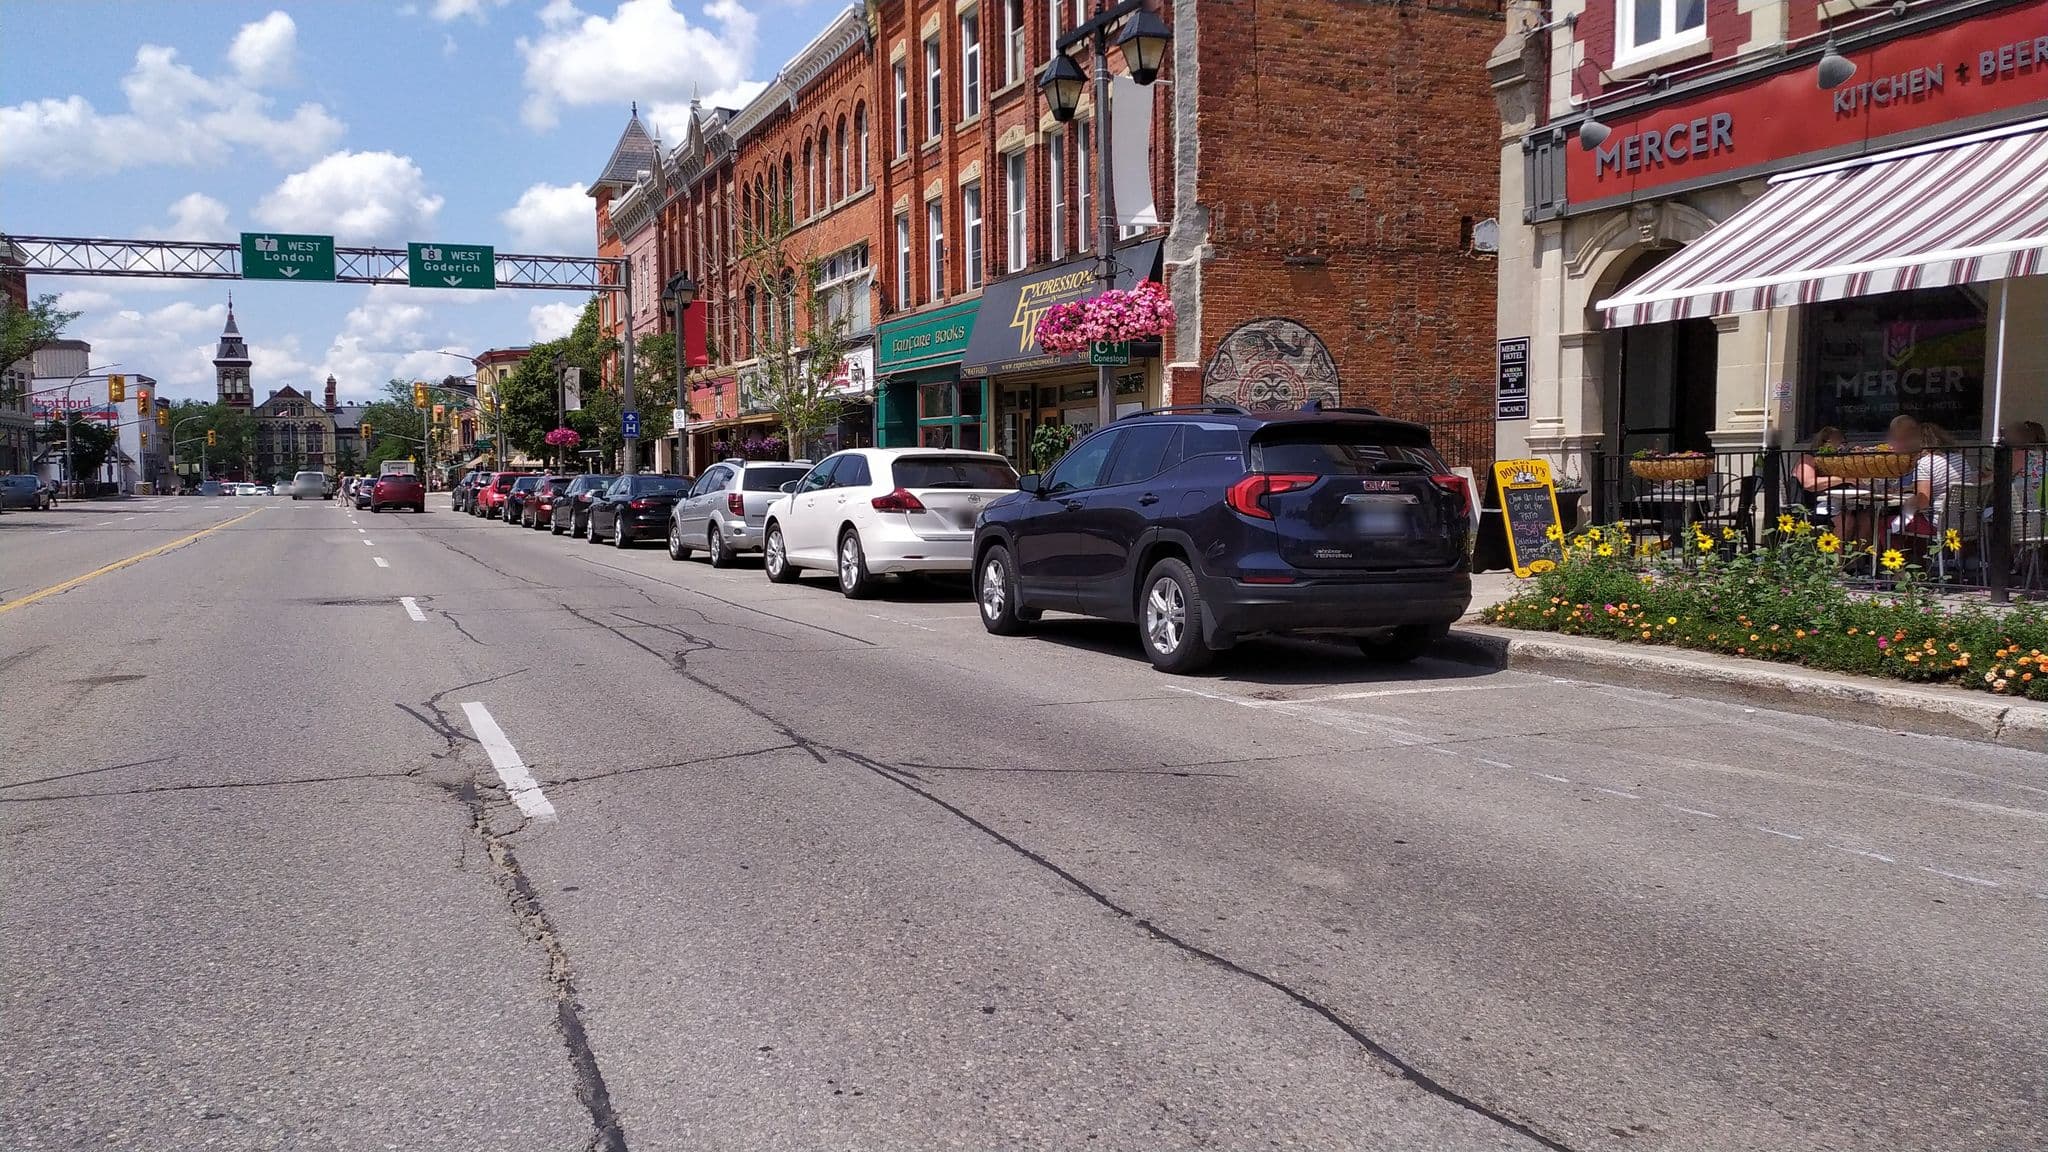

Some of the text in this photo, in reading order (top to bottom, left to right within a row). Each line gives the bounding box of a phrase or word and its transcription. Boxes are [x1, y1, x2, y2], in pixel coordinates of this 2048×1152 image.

[1833, 62, 1945, 113] KITCHEN
[1978, 35, 2048, 77] BEER
[1595, 112, 1735, 178] MERCER
[262, 240, 321, 251] 7 WEST
[264, 252, 314, 262] London
[427, 250, 482, 261] 8 WEST
[423, 262, 480, 273] Goderich
[1501, 343, 1526, 353] MERCER
[1094, 354, 1127, 364] Conestoga
[1503, 351, 1524, 361] HOTEL
[1836, 365, 1964, 398] MERCER
[32, 396, 91, 409] tratford
[1500, 405, 1525, 413] VACANCY
[626, 424, 636, 433] H
[1499, 465, 1547, 480] DONNELLY'S
[1363, 480, 1400, 491] GMC
